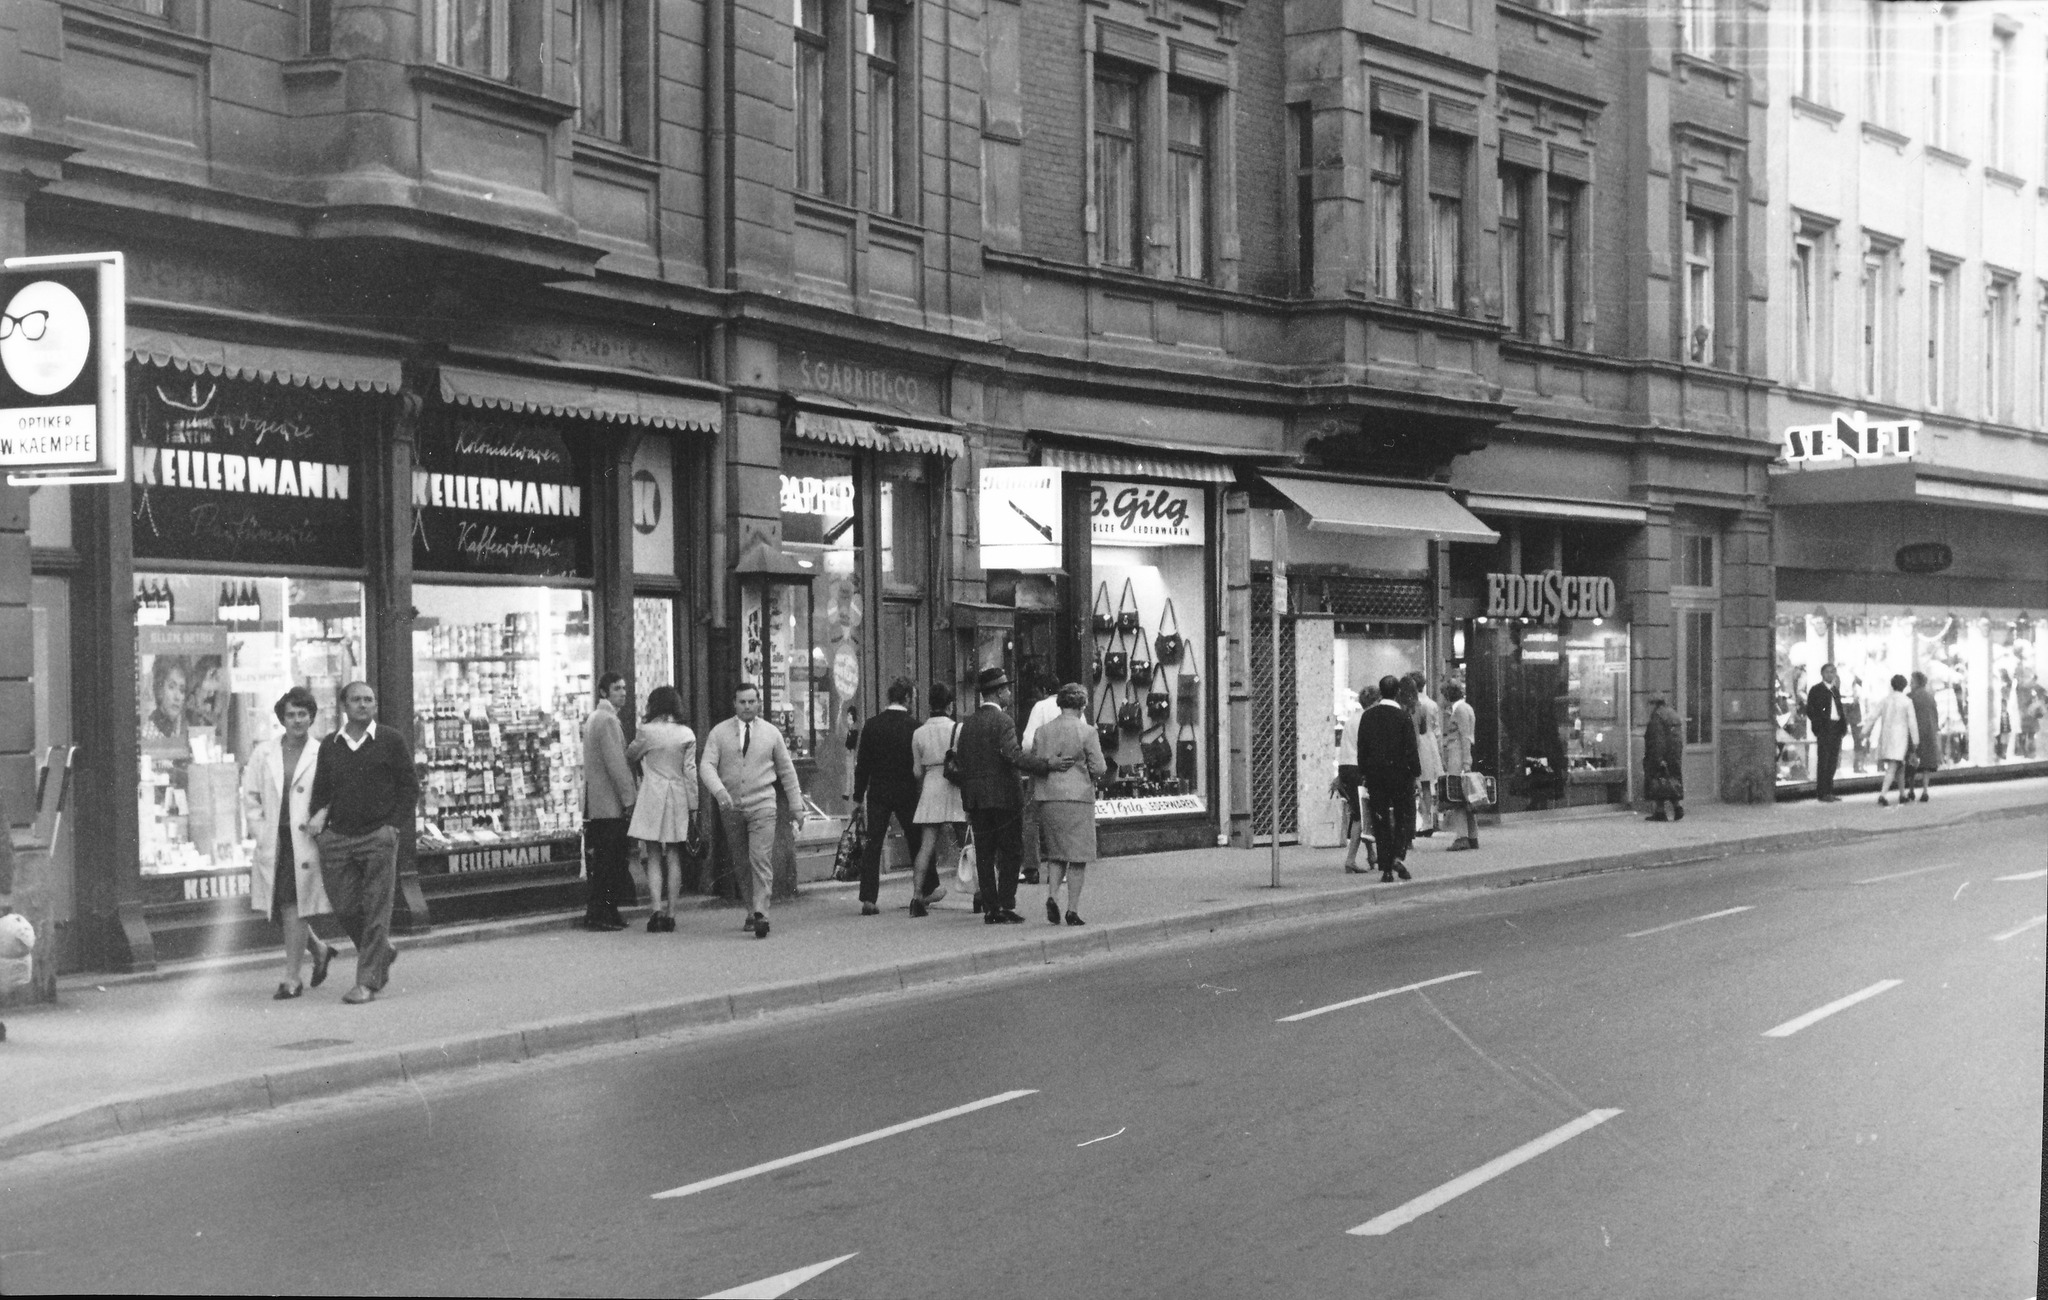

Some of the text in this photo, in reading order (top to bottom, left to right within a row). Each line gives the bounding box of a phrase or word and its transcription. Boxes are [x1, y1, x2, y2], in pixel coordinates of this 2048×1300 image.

[815, 361, 888, 401] GABRIEL
[895, 375, 918, 405] CO
[18, 416, 72, 431] OPTIKER
[19, 435, 91, 454] KAEMPFE
[1785, 410, 1923, 462] SENFT
[132, 445, 349, 501] KELLERMANN
[411, 470, 581, 517] KELLERMANN
[1113, 486, 1190, 531] Gilg
[1133, 524, 1190, 537] LEDERWAREN
[1487, 570, 1616, 625] EDUSCHO
[448, 845, 551, 874] KELLERMANN
[184, 873, 251, 900] KELLER
